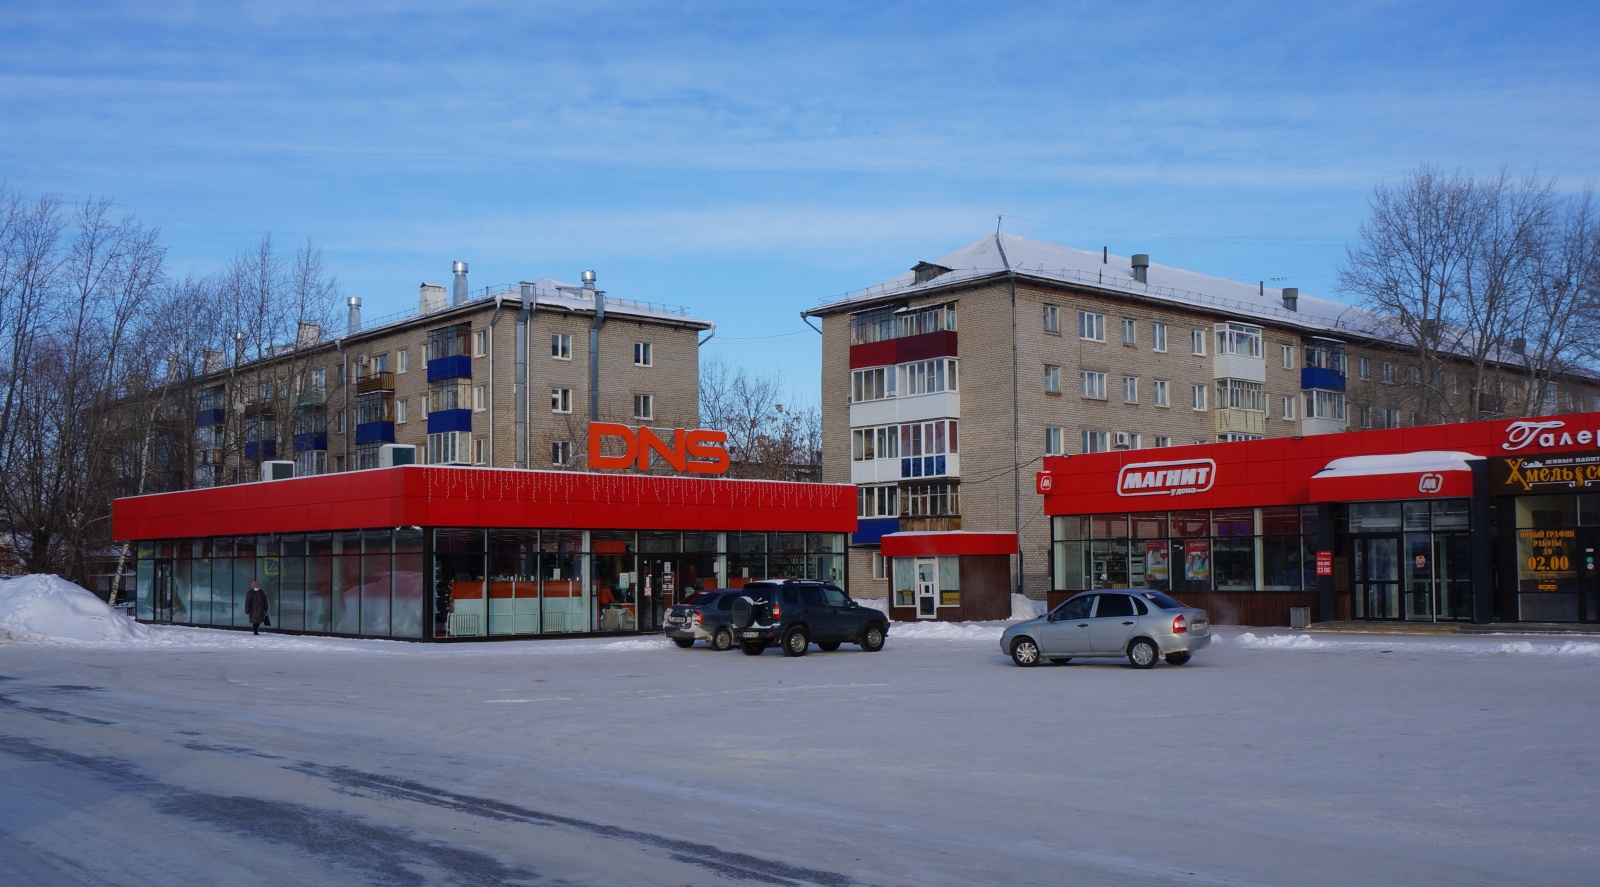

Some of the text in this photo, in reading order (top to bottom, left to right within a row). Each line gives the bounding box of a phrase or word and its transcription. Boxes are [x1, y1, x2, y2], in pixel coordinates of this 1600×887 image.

[1502, 420, 1600, 451] Гале
[588, 421, 730, 474] DNS
[1545, 457, 1573, 465] живые
[1123, 467, 1210, 489] МАГНИТ
[1504, 458, 1574, 491] Хмель
[1520, 530, 1575, 539] НОВЫЙ ГРАФИК
[1527, 556, 1569, 571] 02.00
